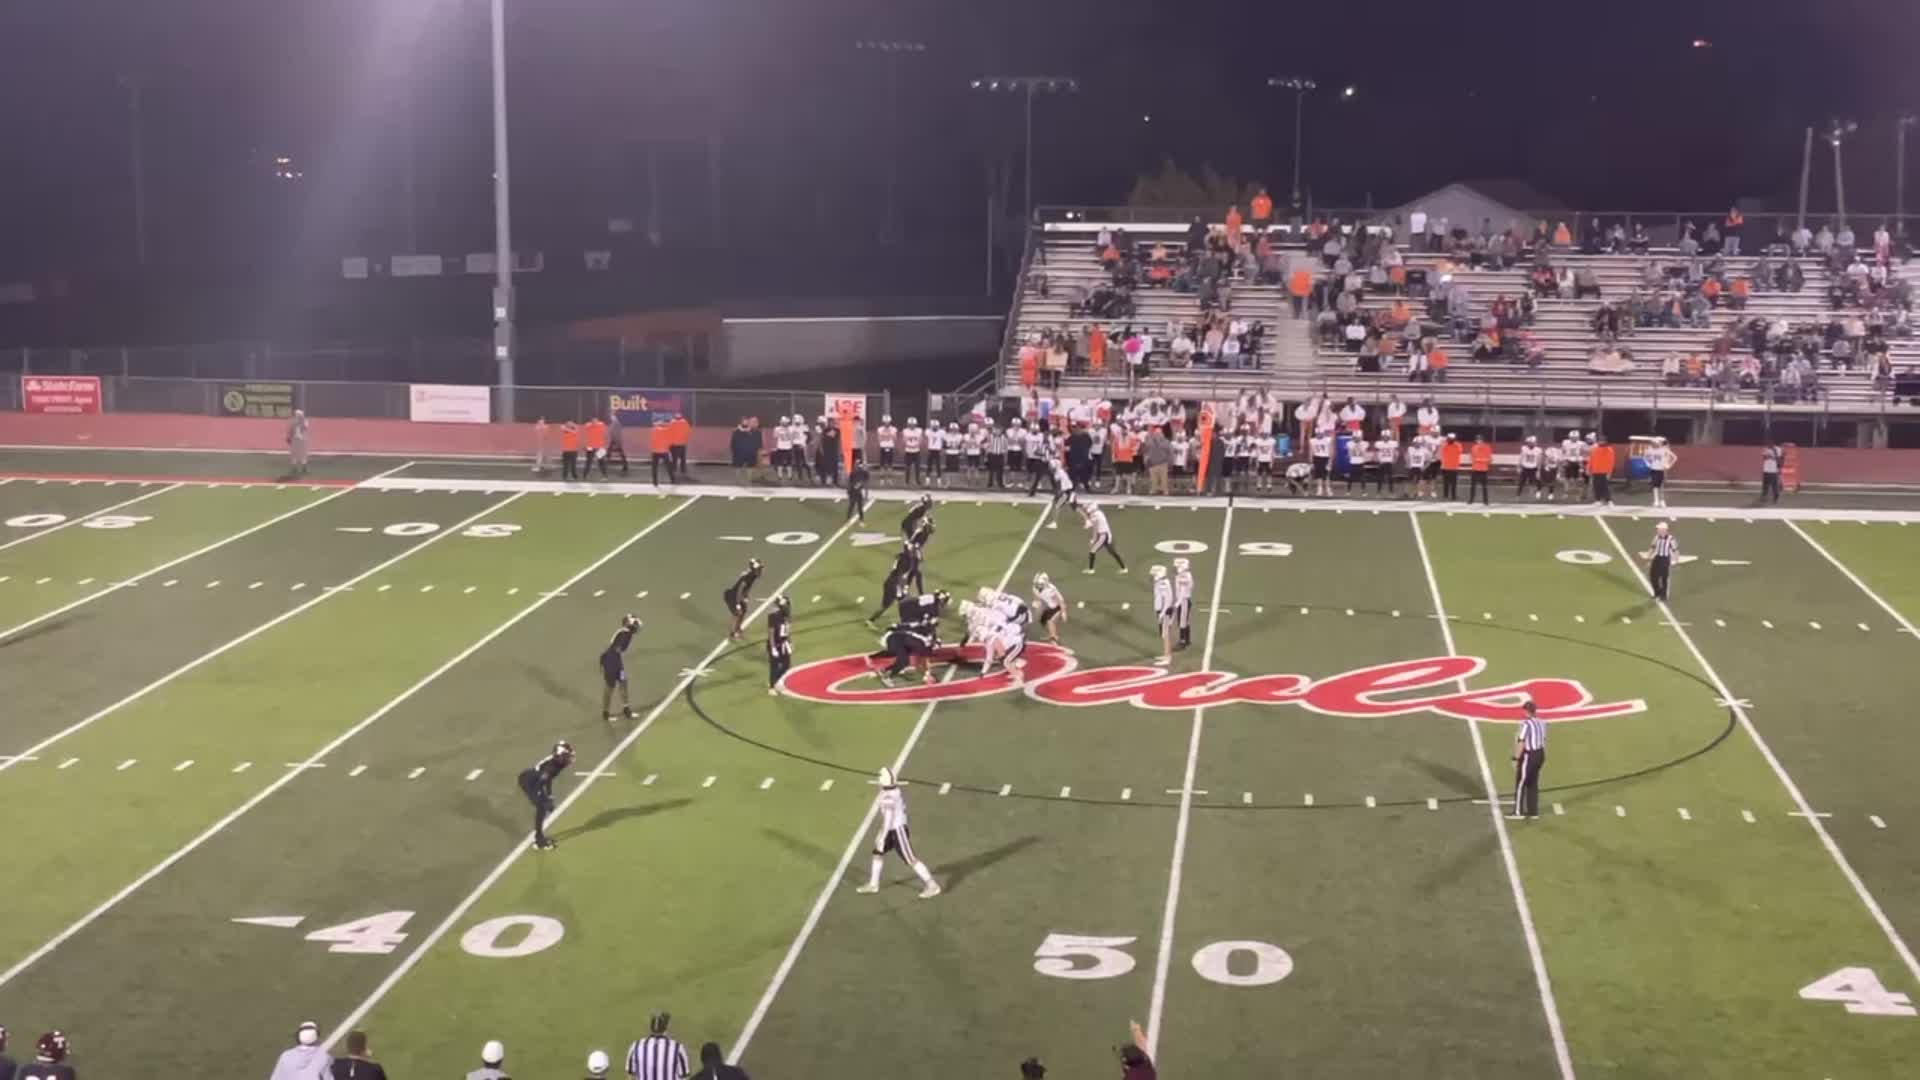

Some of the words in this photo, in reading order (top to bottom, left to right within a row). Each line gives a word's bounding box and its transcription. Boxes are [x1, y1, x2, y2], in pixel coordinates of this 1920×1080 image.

[609, 395, 648, 411] Built
[779, 640, 1647, 723] Owls
[303, 909, 564, 958] 40
[1033, 932, 1294, 986] 50
[1799, 966, 1918, 1015] 4
